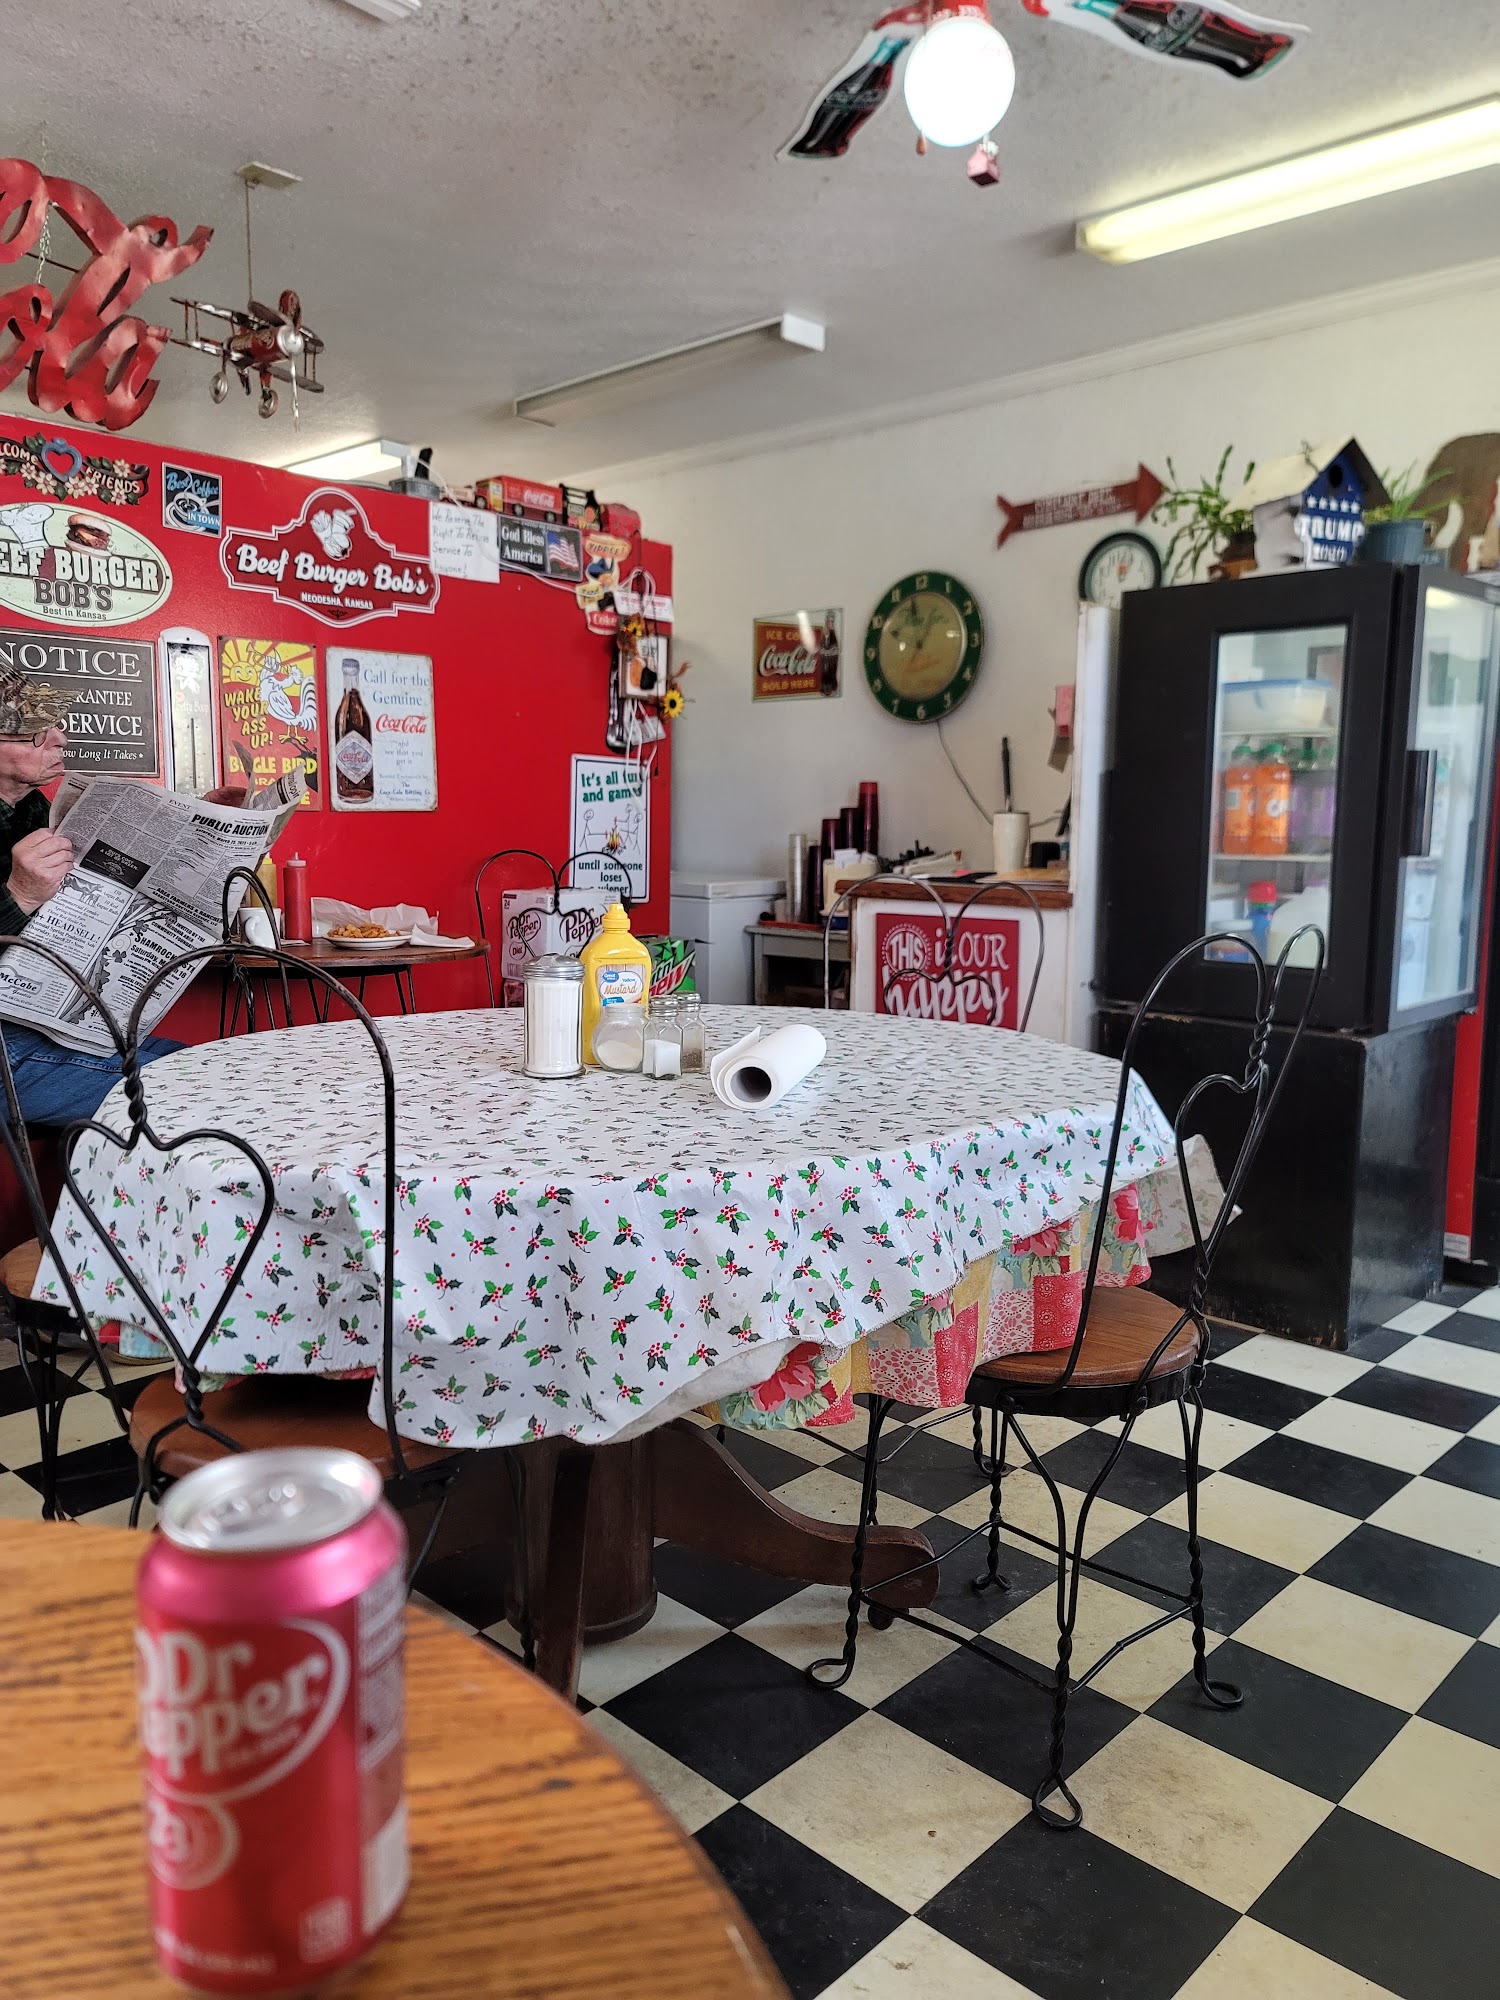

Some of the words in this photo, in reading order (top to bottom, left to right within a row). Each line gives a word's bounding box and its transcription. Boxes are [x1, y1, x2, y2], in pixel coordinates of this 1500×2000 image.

[0, 442, 38, 465] COME
[86, 467, 140, 494] FRIENDS
[166, 472, 190, 492] Best
[191, 479, 219, 496] Coffee
[188, 511, 196, 521] IN
[197, 514, 220, 526] TOWN
[501, 525, 520, 542] God
[523, 529, 545, 547] Bless
[1296, 516, 1365, 542] TRUMP
[432, 541, 460, 555] Service
[462, 545, 474, 557] To
[503, 544, 543, 565] America
[0, 541, 45, 576] EEF
[54, 548, 159, 591] BURGER
[236, 543, 289, 582] Beef
[294, 552, 369, 594] Burger
[373, 563, 429, 595] Bob's
[33, 577, 113, 611] BOB'S
[345, 596, 373, 610] KANSAS
[43, 605, 61, 616] Best
[65, 607, 73, 616] In
[76, 610, 107, 621] Kansas
[592, 614, 618, 626] Coke
[0, 642, 140, 677] NOTICE
[364, 668, 387, 684] Call
[392, 670, 408, 686] for
[410, 672, 430, 687] the
[762, 680, 789, 692] SOLD
[225, 687, 261, 707] WAKE
[233, 700, 269, 722] YOUR
[60, 712, 143, 736] SERVICE
[241, 718, 266, 736] ASS
[251, 732, 273, 749] UP!
[63, 749, 77, 758] ow
[79, 749, 101, 761] Long
[103, 750, 111, 759] It
[114, 750, 137, 760] Takes
[581, 772, 601, 787] It's
[605, 771, 618, 784] all
[168, 799, 191, 810] EVENT
[583, 788, 603, 802] and
[190, 813, 233, 834] PUBLIC
[232, 823, 270, 836] AUCTION
[578, 860, 601, 870] until
[600, 872, 622, 882] loses
[508, 916, 538, 939] Pepper
[519, 914, 531, 925] Dr
[46, 915, 75, 933] HEAD
[74, 927, 100, 944] SELL!
[512, 945, 523, 955] Diet
[889, 932, 926, 973] THIS
[958, 931, 1010, 970] OUR
[604, 982, 638, 995] Mustard
[882, 963, 1009, 1026] happy
[160, 1631, 254, 1704] Dr
